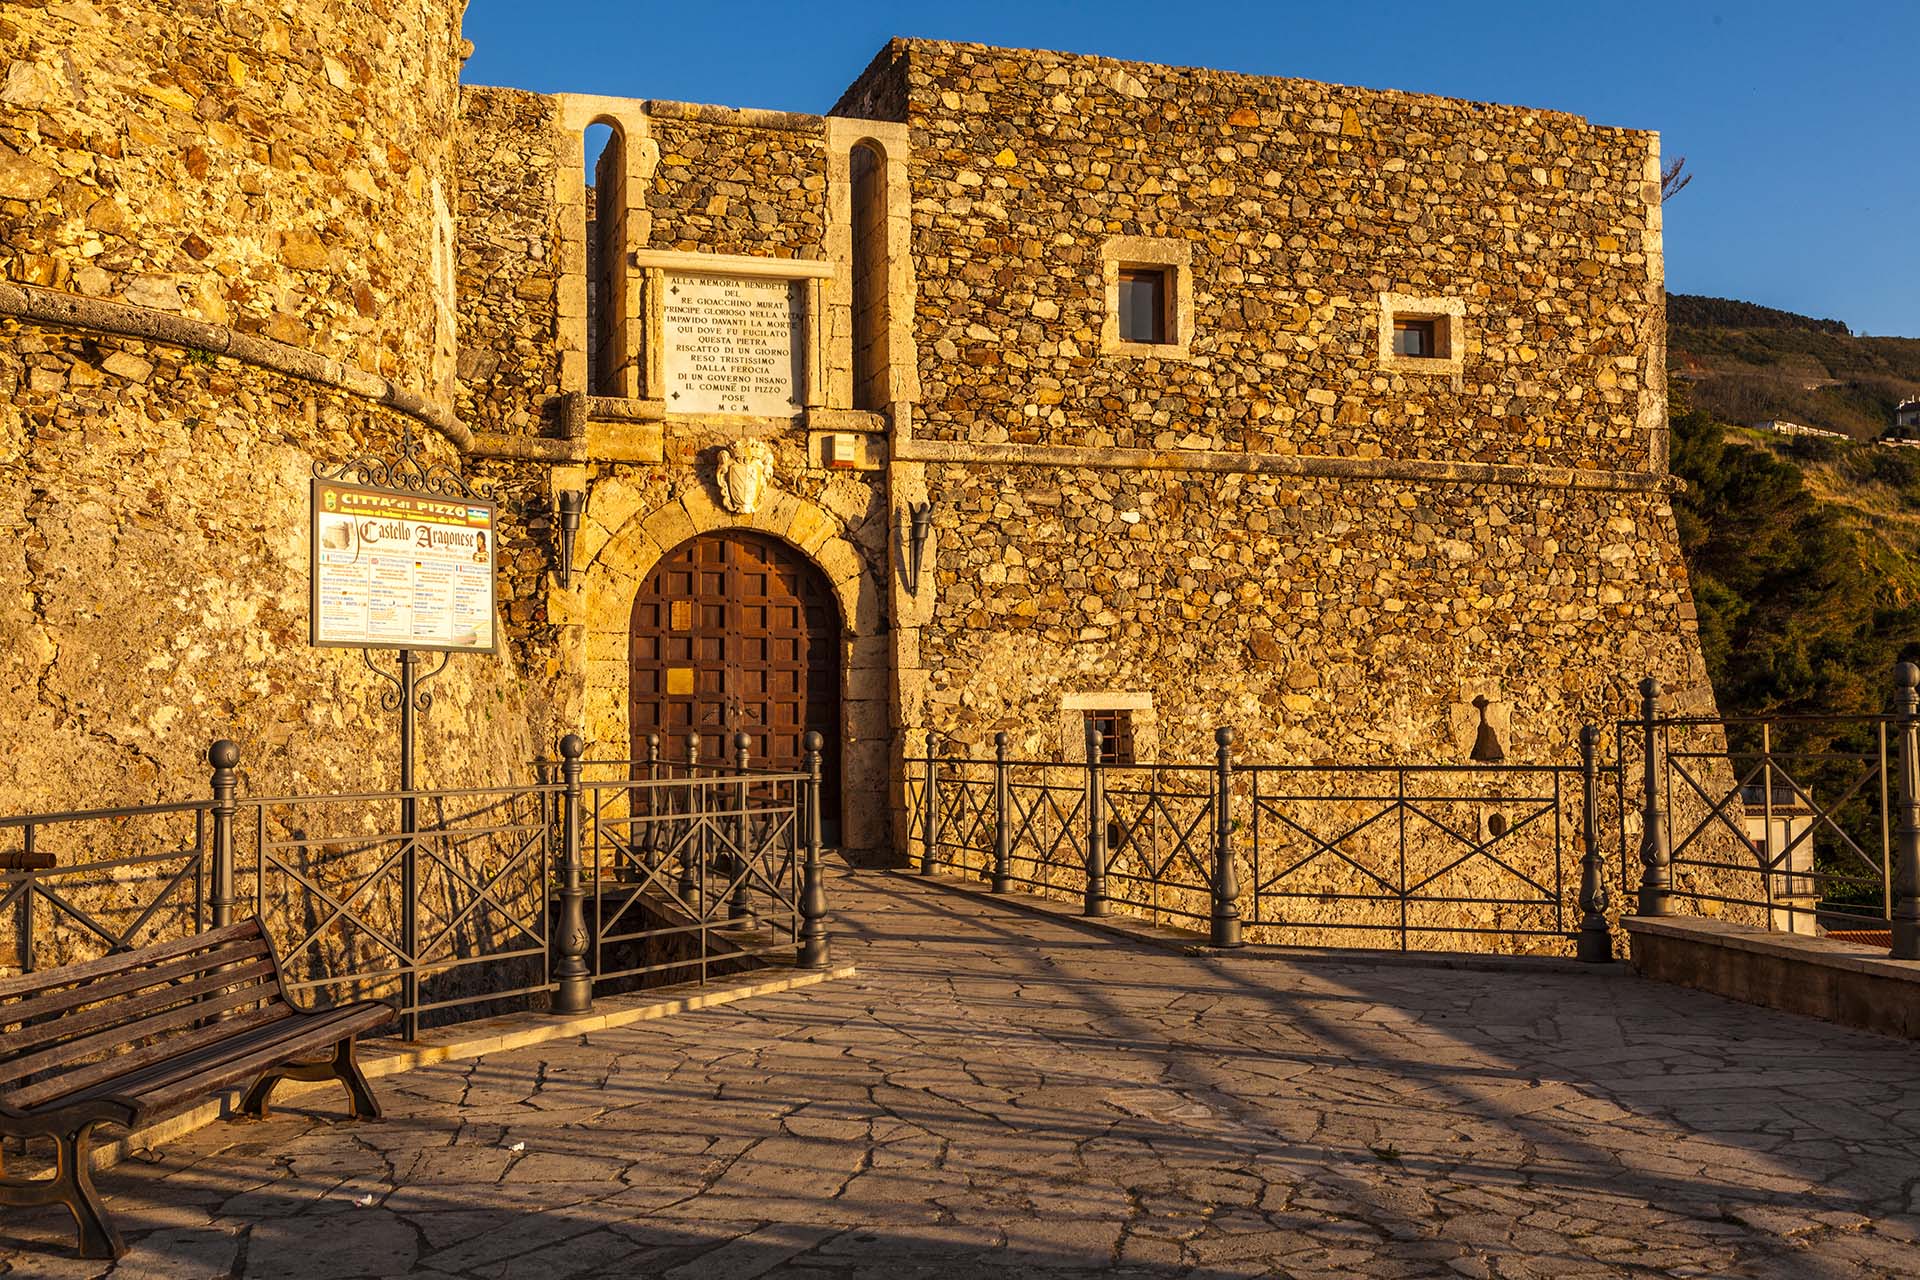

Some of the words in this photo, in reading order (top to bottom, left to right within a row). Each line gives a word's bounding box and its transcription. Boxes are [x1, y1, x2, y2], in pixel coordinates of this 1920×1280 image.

[700, 279, 740, 288] MEMORIA
[745, 281, 792, 290] BENEDETTA
[697, 298, 752, 307] GIOACCHINO
[664, 306, 700, 314] PRINCIPE
[704, 308, 746, 316] GLORIOSO
[712, 318, 746, 326] DAVANTI
[767, 321, 797, 329] MORTE
[743, 329, 787, 337] FUCILATO
[699, 336, 731, 344] QUESTA
[737, 338, 767, 346] PIETRA
[676, 344, 720, 353] RISCATTO
[721, 356, 775, 365] TRISTISSIMO
[696, 364, 726, 372] DALLA
[731, 366, 770, 374] FEROCIA
[707, 374, 751, 382] GOVERNO
[700, 383, 737, 392] COMUNE
[417, 501, 466, 518] PIZZO
[360, 520, 411, 543] Castello
[415, 525, 473, 550] Aragonese
